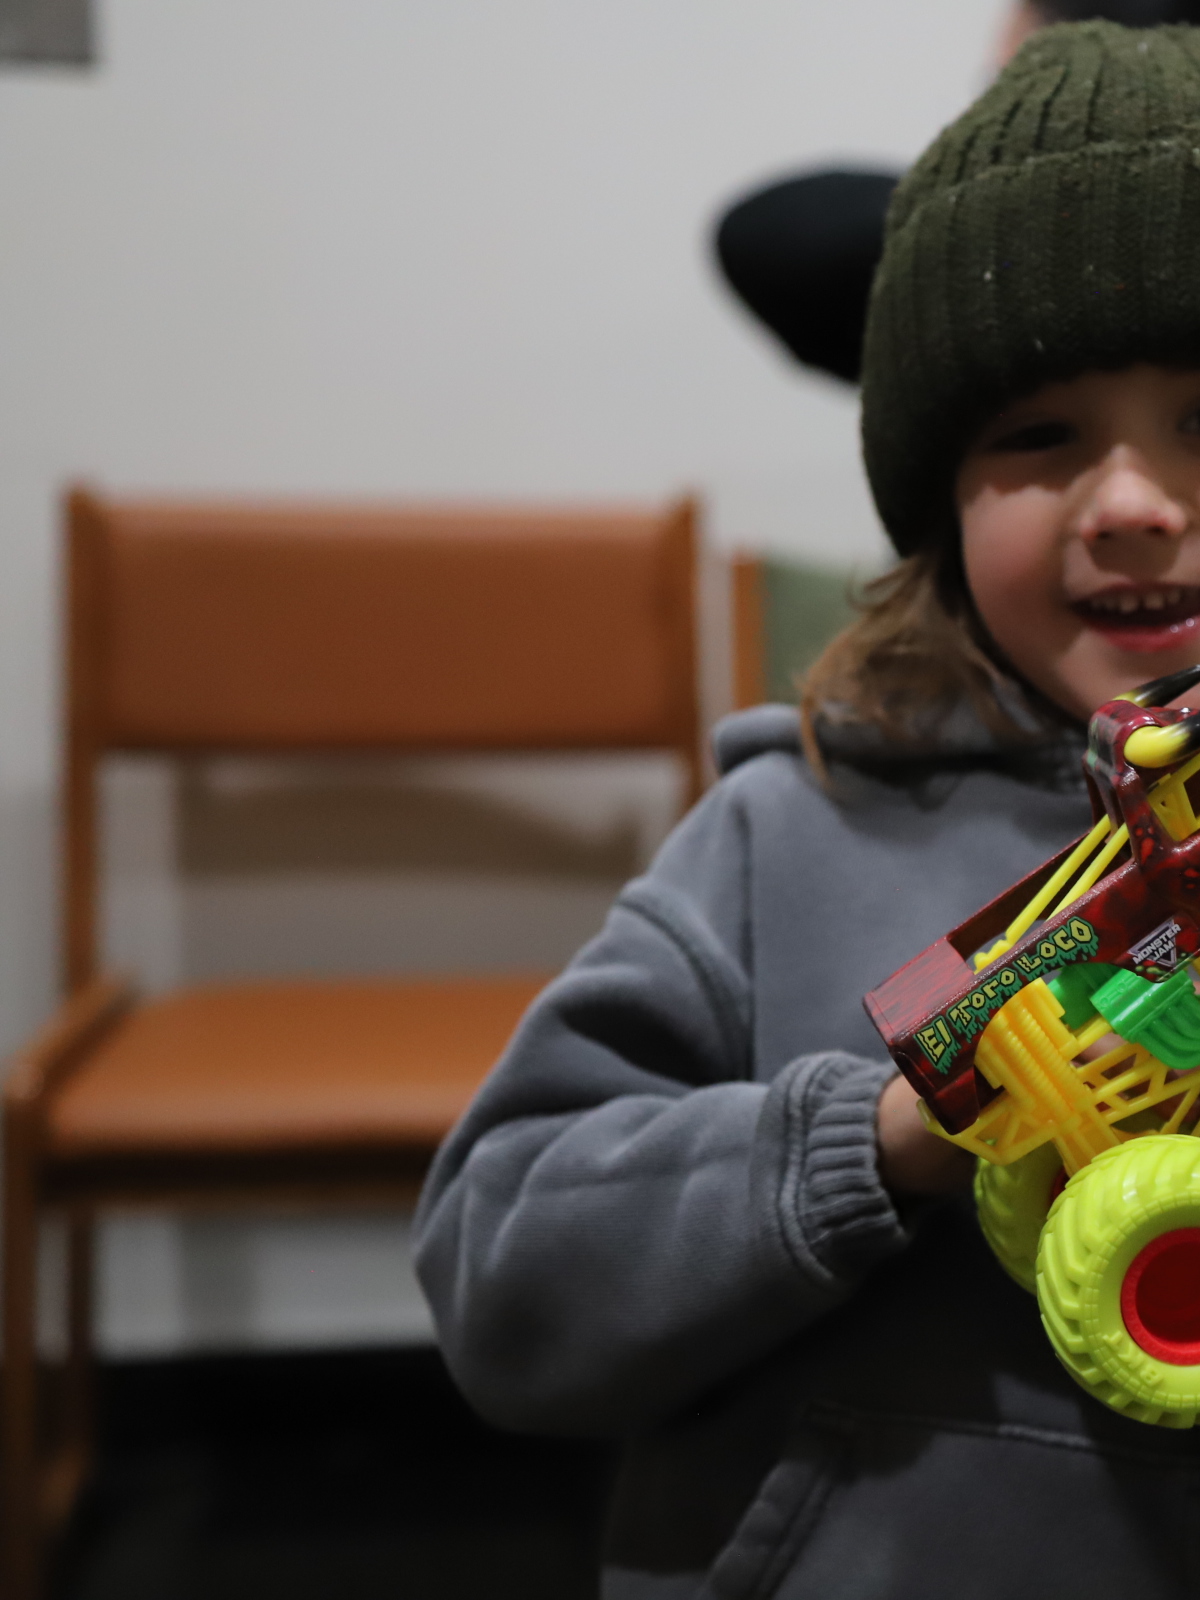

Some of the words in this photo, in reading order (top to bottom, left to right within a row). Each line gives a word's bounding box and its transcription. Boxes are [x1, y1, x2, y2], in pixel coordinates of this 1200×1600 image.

[1132, 923, 1182, 965] MONSTER
[1153, 940, 1175, 961] JAM
[915, 1018, 954, 1068] El
[949, 967, 1017, 1028] Toro
